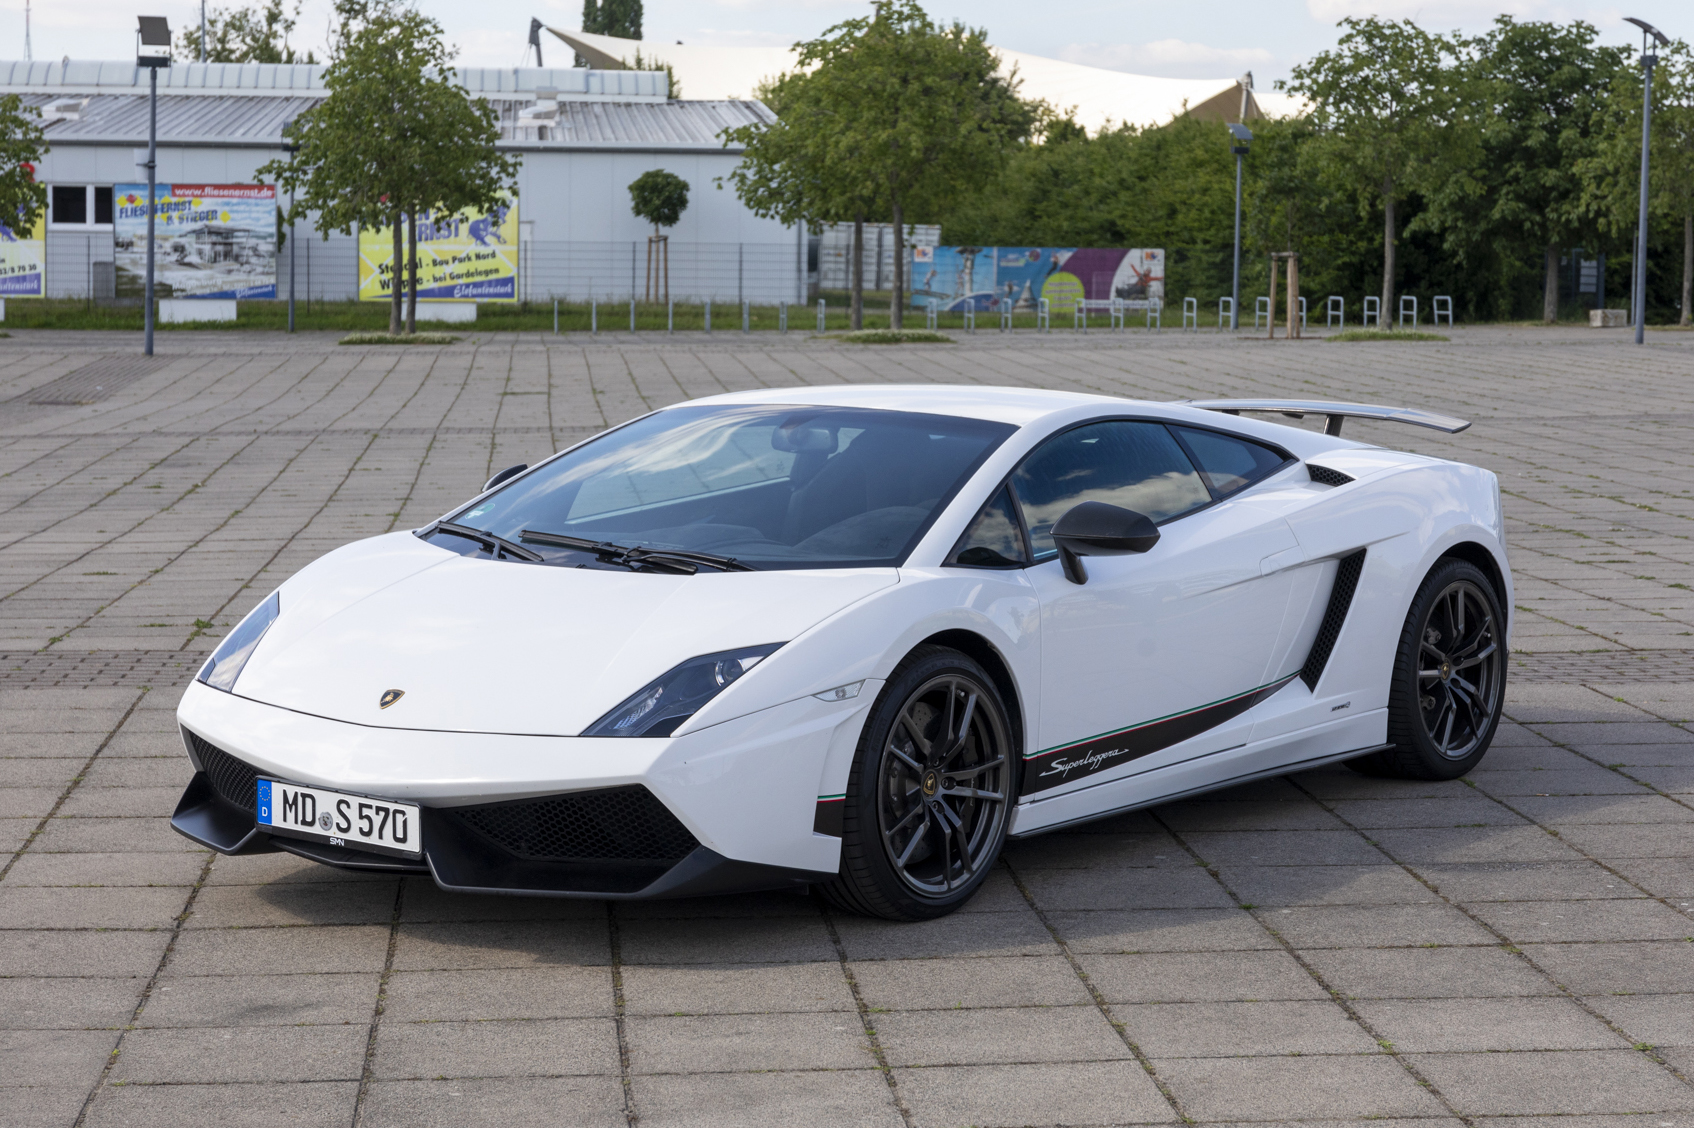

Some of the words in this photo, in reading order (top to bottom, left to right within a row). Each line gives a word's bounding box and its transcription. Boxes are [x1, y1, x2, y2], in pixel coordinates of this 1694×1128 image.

[174, 187, 273, 197] www.fliesenernst.de
[161, 199, 193, 213] ERNST
[178, 210, 218, 224] STIEGER
[417, 218, 460, 242] RNST
[432, 257, 449, 267] Bau
[452, 253, 472, 264] Park
[475, 249, 497, 261] Nord
[433, 273, 446, 283] bei
[449, 267, 500, 280] Gardelegen
[453, 283, 513, 298] Elefantenstark
[1039, 748, 1130, 778] Superleggera
[261, 806, 269, 818] D
[283, 788, 316, 827] MD
[335, 799, 351, 833] S
[358, 802, 408, 844] 570
[329, 837, 345, 847] SMN
